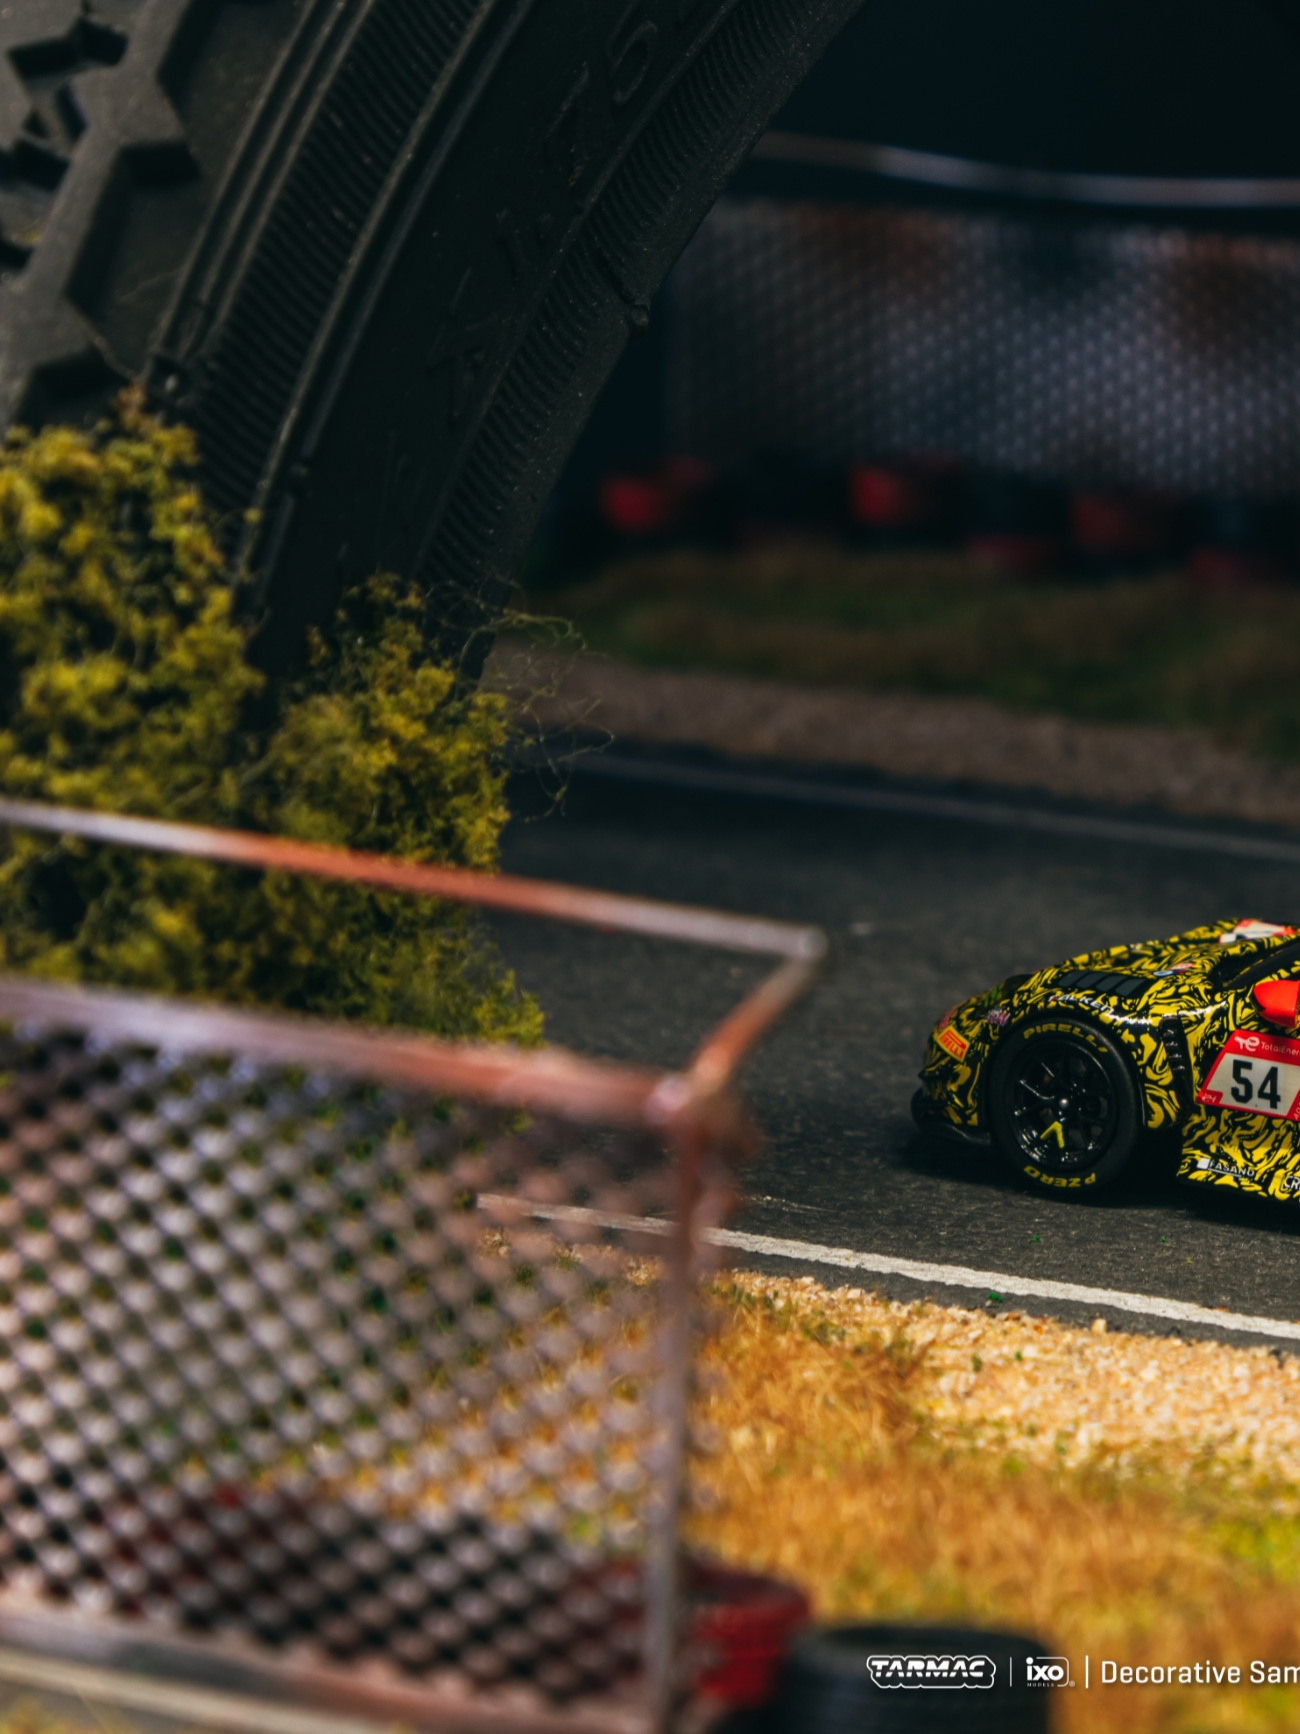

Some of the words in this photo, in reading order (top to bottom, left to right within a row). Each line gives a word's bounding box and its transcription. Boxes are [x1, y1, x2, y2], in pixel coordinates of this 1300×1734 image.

[1022, 1023, 1108, 1053] PIRELLI
[1230, 1059, 1282, 1111] 54
[1024, 1165, 1082, 1188] ZERO
[1209, 1159, 1255, 1178] FASANO
